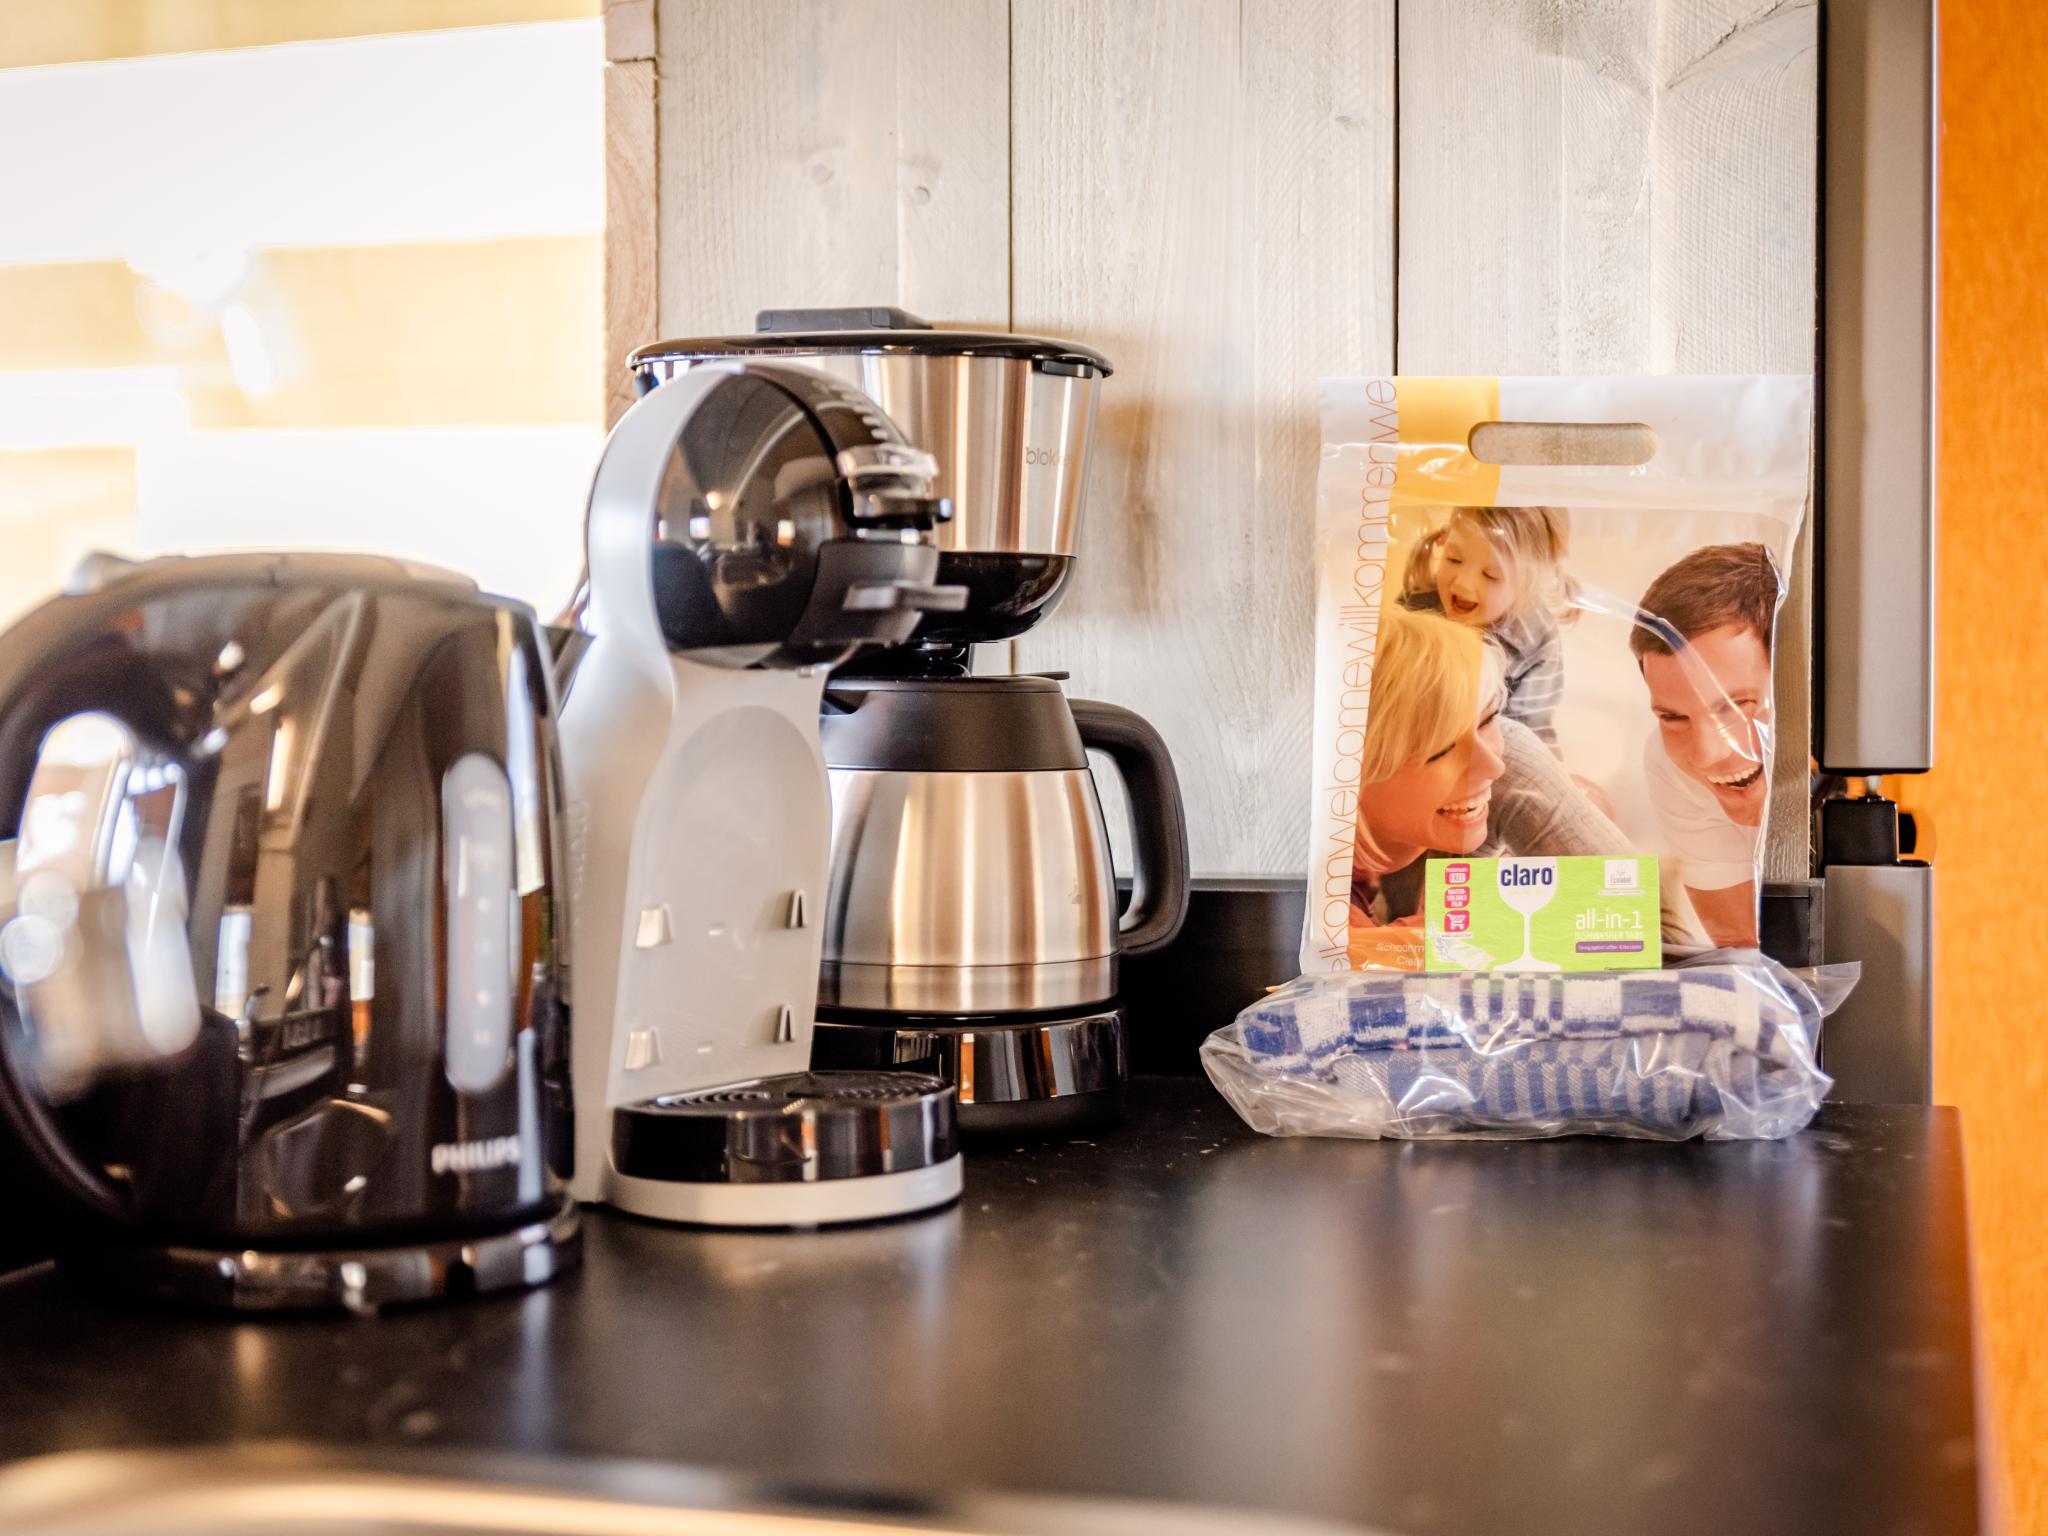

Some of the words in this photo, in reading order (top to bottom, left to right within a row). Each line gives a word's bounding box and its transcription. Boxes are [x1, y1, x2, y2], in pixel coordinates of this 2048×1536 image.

[1501, 864, 1552, 886] claro
[1576, 908, 1643, 929] all-in-1
[433, 1134, 519, 1175] PHILIPS
